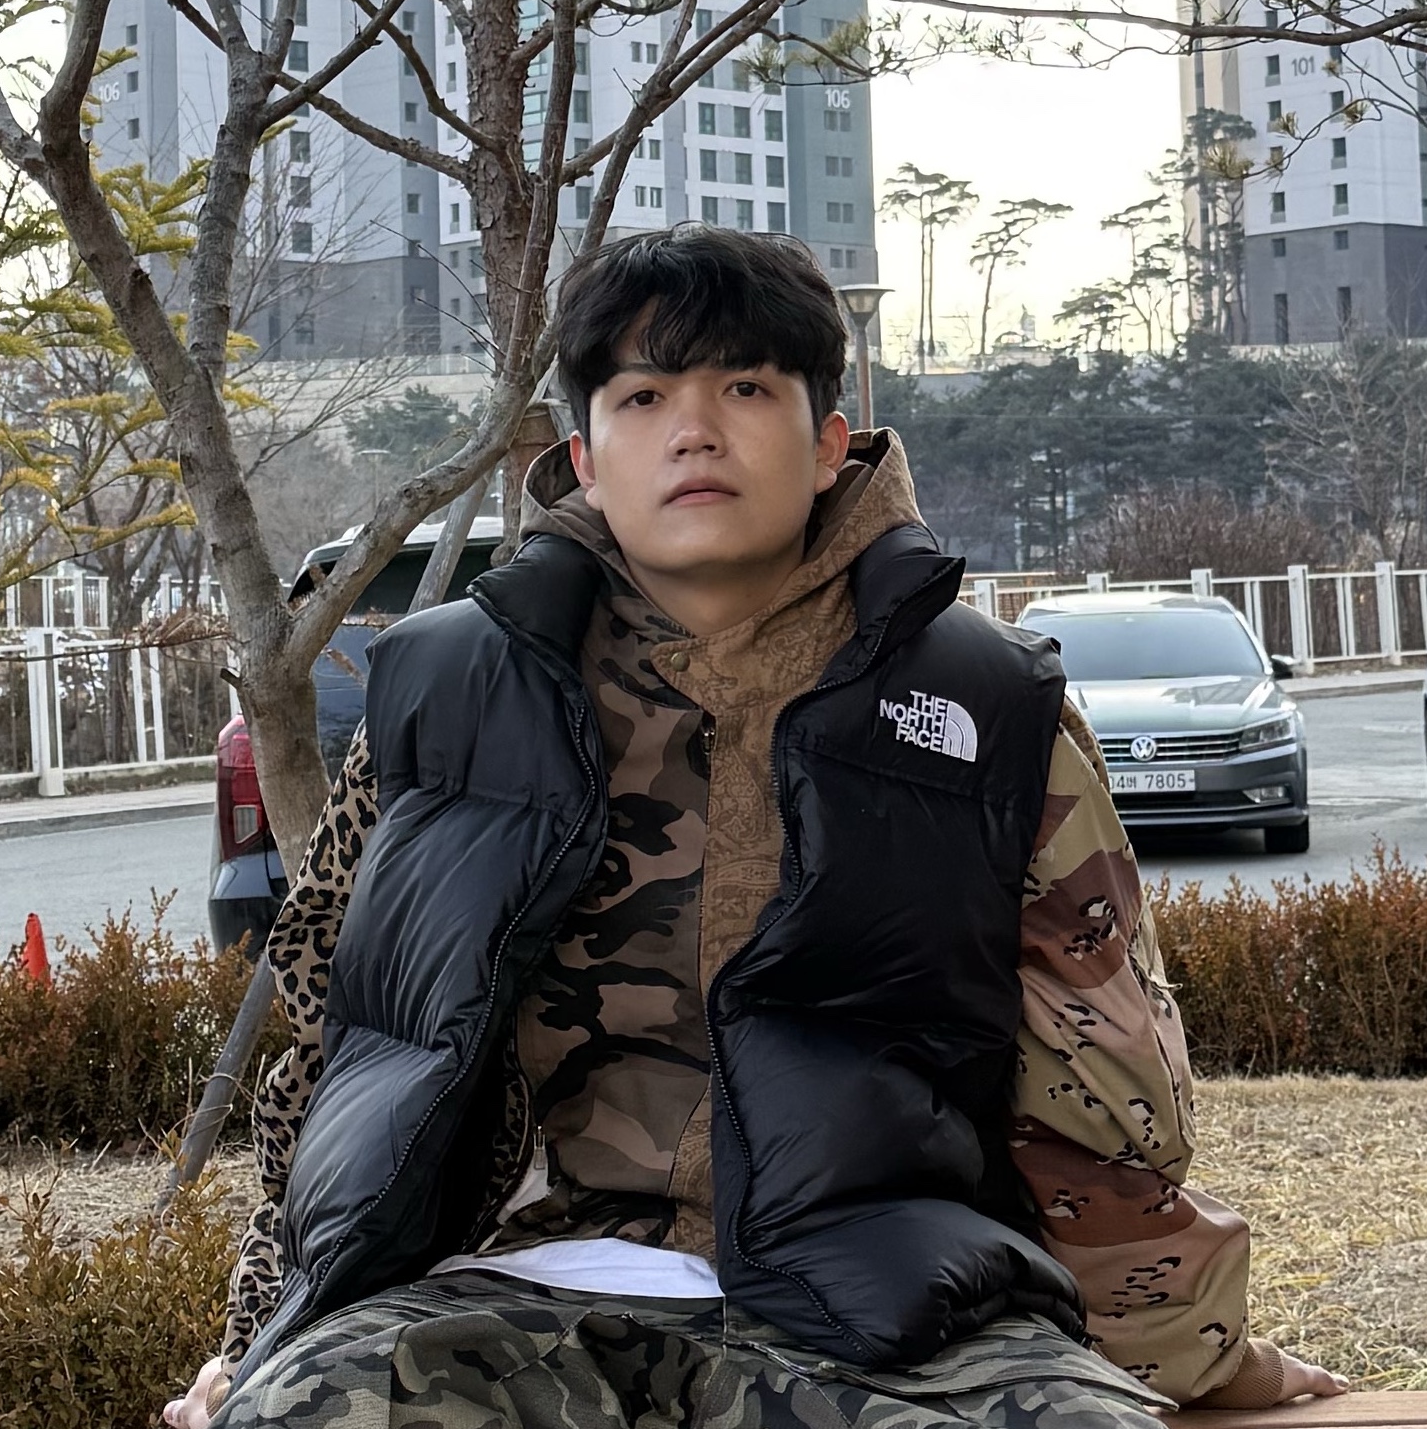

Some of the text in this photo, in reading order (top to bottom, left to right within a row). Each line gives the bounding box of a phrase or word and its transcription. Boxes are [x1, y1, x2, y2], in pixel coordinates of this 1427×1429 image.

[1291, 56, 1315, 77] 101
[98, 81, 121, 103] 106
[824, 88, 851, 109] 106
[909, 690, 948, 717] THE
[879, 698, 947, 734] NORTH
[895, 723, 944, 753] FACE
[1145, 773, 1187, 789] 7805
